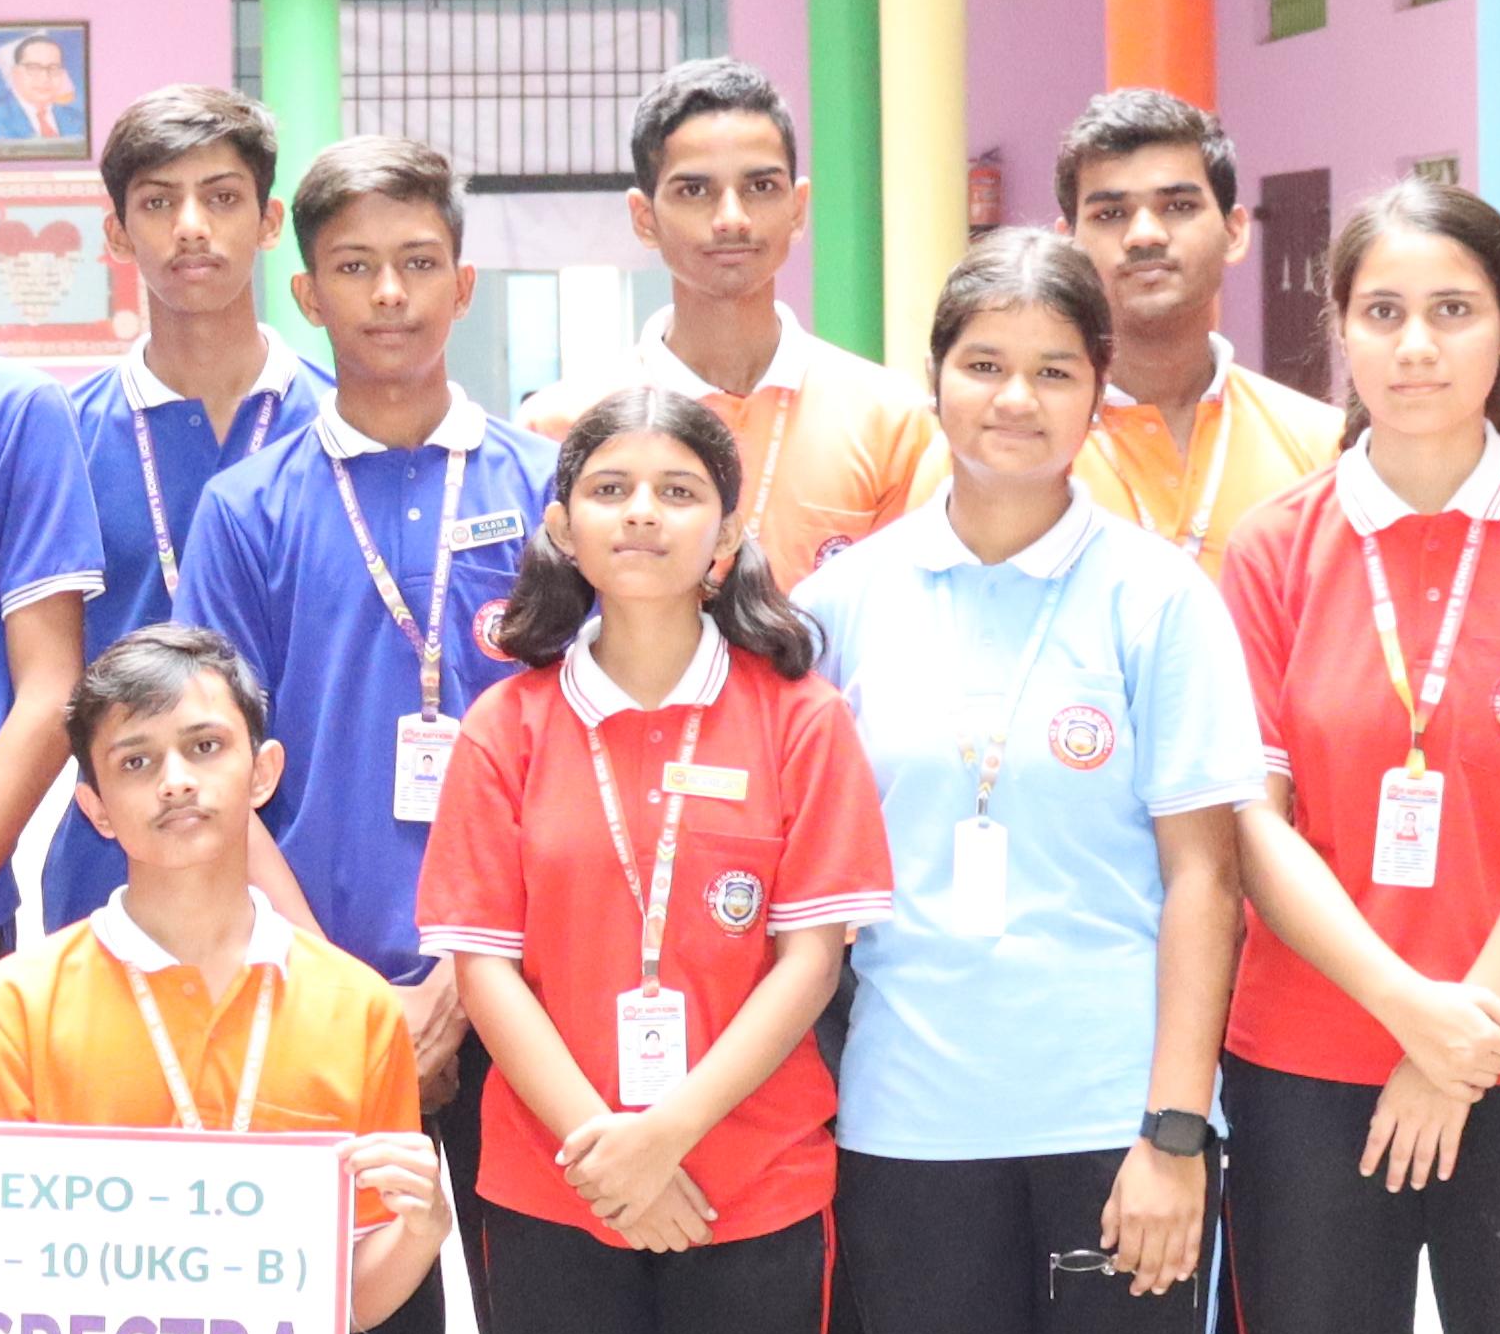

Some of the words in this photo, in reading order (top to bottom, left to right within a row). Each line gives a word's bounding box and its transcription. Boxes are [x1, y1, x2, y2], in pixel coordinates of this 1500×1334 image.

[141, 459, 158, 497] SCHOOL
[148, 497, 165, 534] MARY'S
[434, 548, 449, 586] SCHOOL
[1366, 554, 1387, 600] BUXAR
[1451, 544, 1476, 596] SCHOOL
[428, 587, 444, 626] MARY'S
[1436, 595, 1462, 646] MARY'S
[1430, 644, 1447, 668] ST.
[1, 1173, 134, 1213] EXPO
[40, 1242, 88, 1278] 10
[100, 1242, 209, 1285] (UKG
